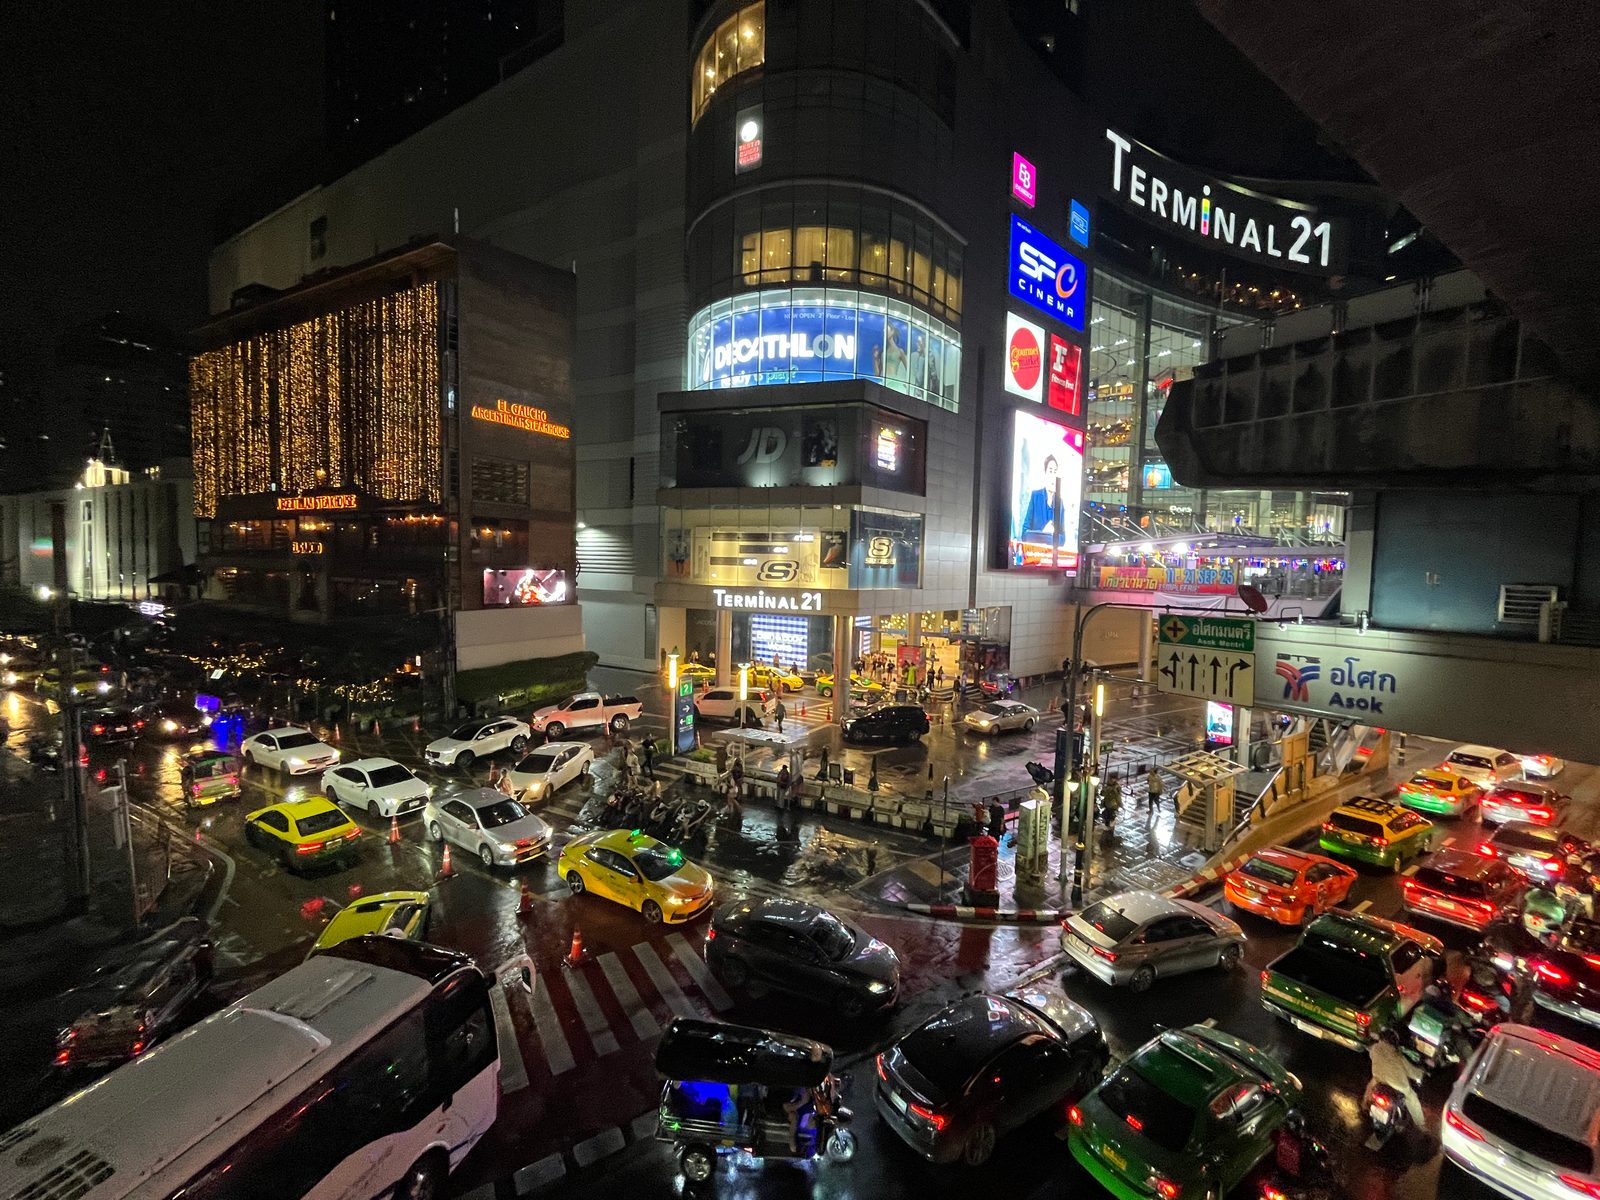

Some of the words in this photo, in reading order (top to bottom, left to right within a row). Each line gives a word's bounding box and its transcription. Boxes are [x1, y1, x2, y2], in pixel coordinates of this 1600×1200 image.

[1288, 216, 1331, 267] 21
[1018, 278, 1074, 318] CINEMA
[714, 333, 856, 370] DECATHLON
[497, 399, 511, 414] EL
[510, 403, 547, 423] GAUCHO
[524, 418, 570, 439] STEAKHOUSE
[737, 427, 787, 465] JD
[1184, 568, 1195, 584] 21
[1198, 569, 1217, 584] SEP
[1220, 569, 1234, 585] 25
[801, 592, 822, 611] 21
[1192, 618, 1252, 640] อโศกมนตรี
[1198, 638, 1216, 646] Asok
[1329, 656, 1396, 693] อโศก
[1328, 692, 1383, 714] Asok
